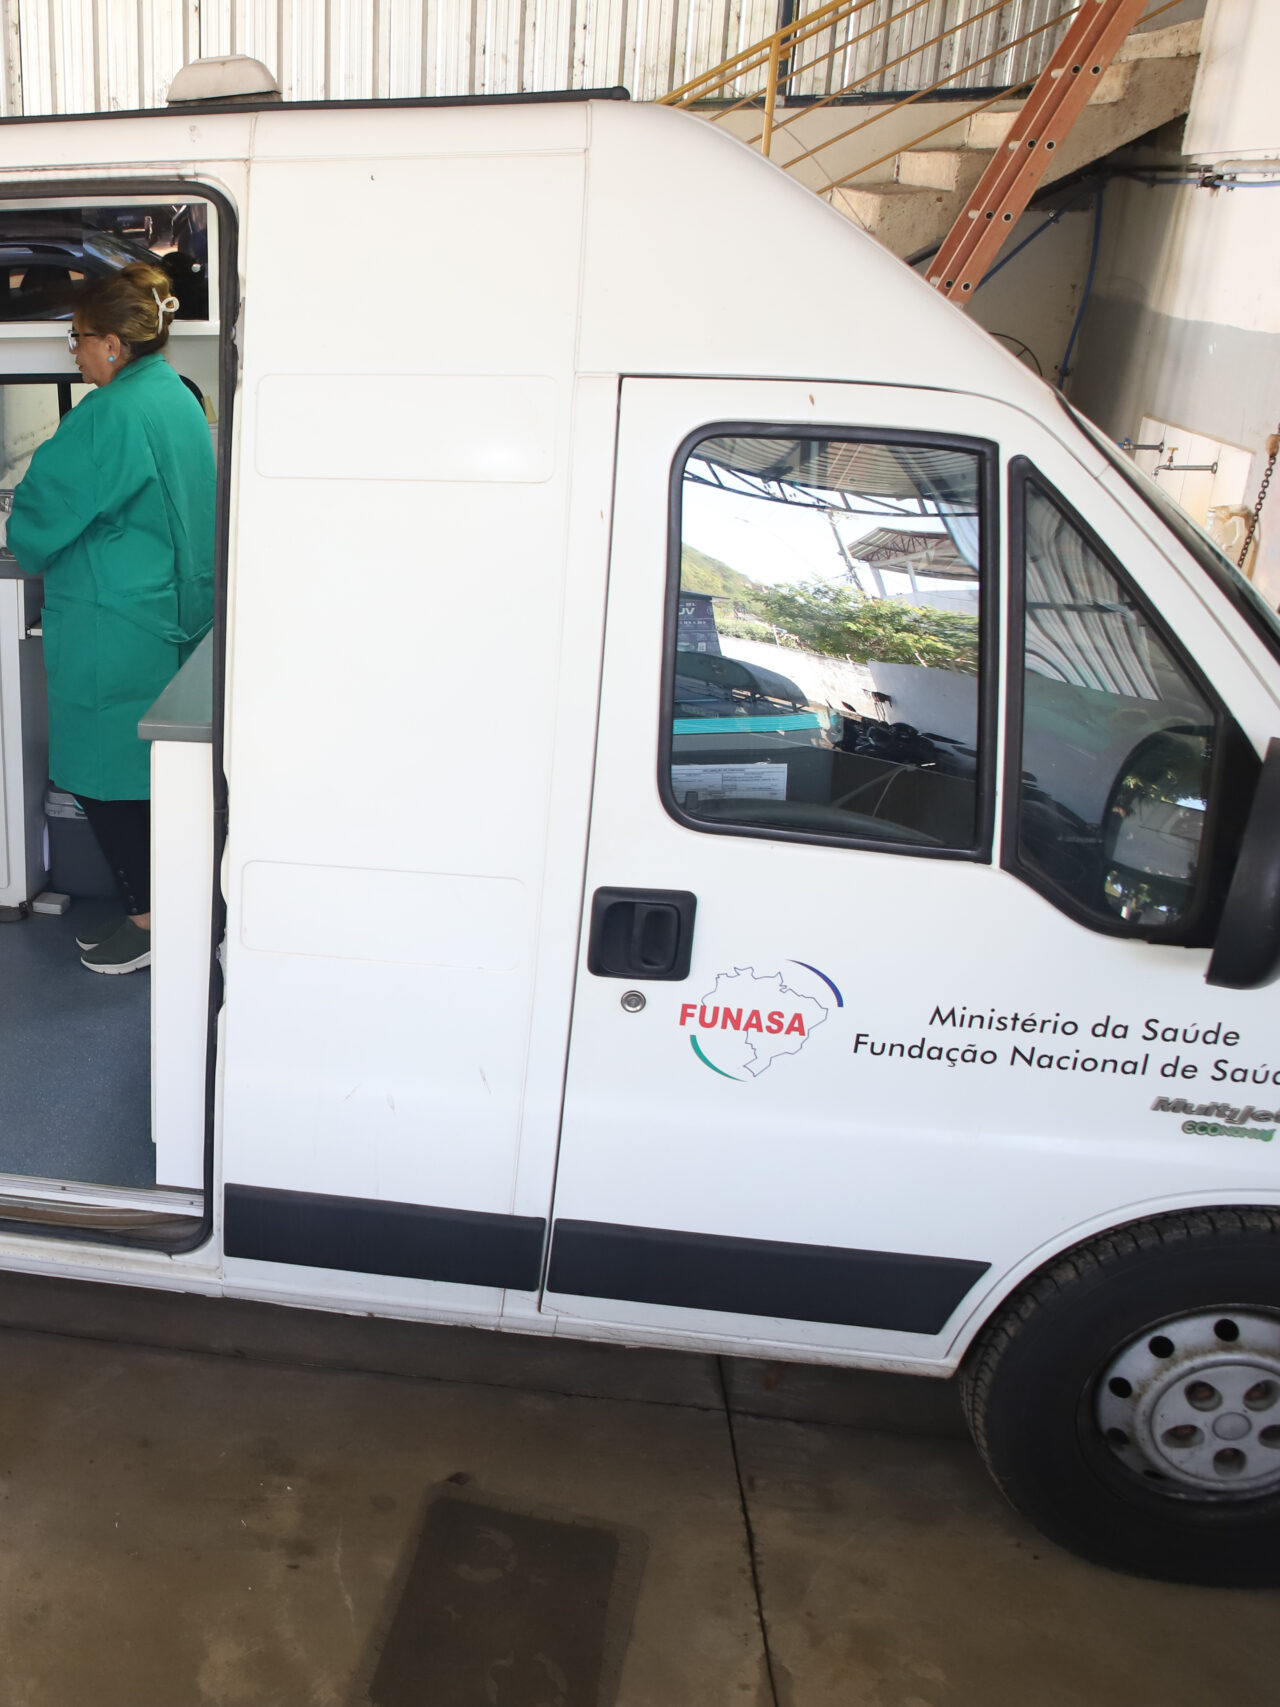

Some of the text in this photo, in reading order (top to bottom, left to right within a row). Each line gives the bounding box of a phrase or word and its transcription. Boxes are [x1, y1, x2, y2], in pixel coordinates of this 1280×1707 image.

[679, 1003, 806, 1036] FUNASA
[929, 1005, 1240, 1047] Ministério da Saúde
[853, 1034, 998, 1067] Fundação
[1010, 1045, 1148, 1076] Nacional
[1160, 1054, 1198, 1081] de
